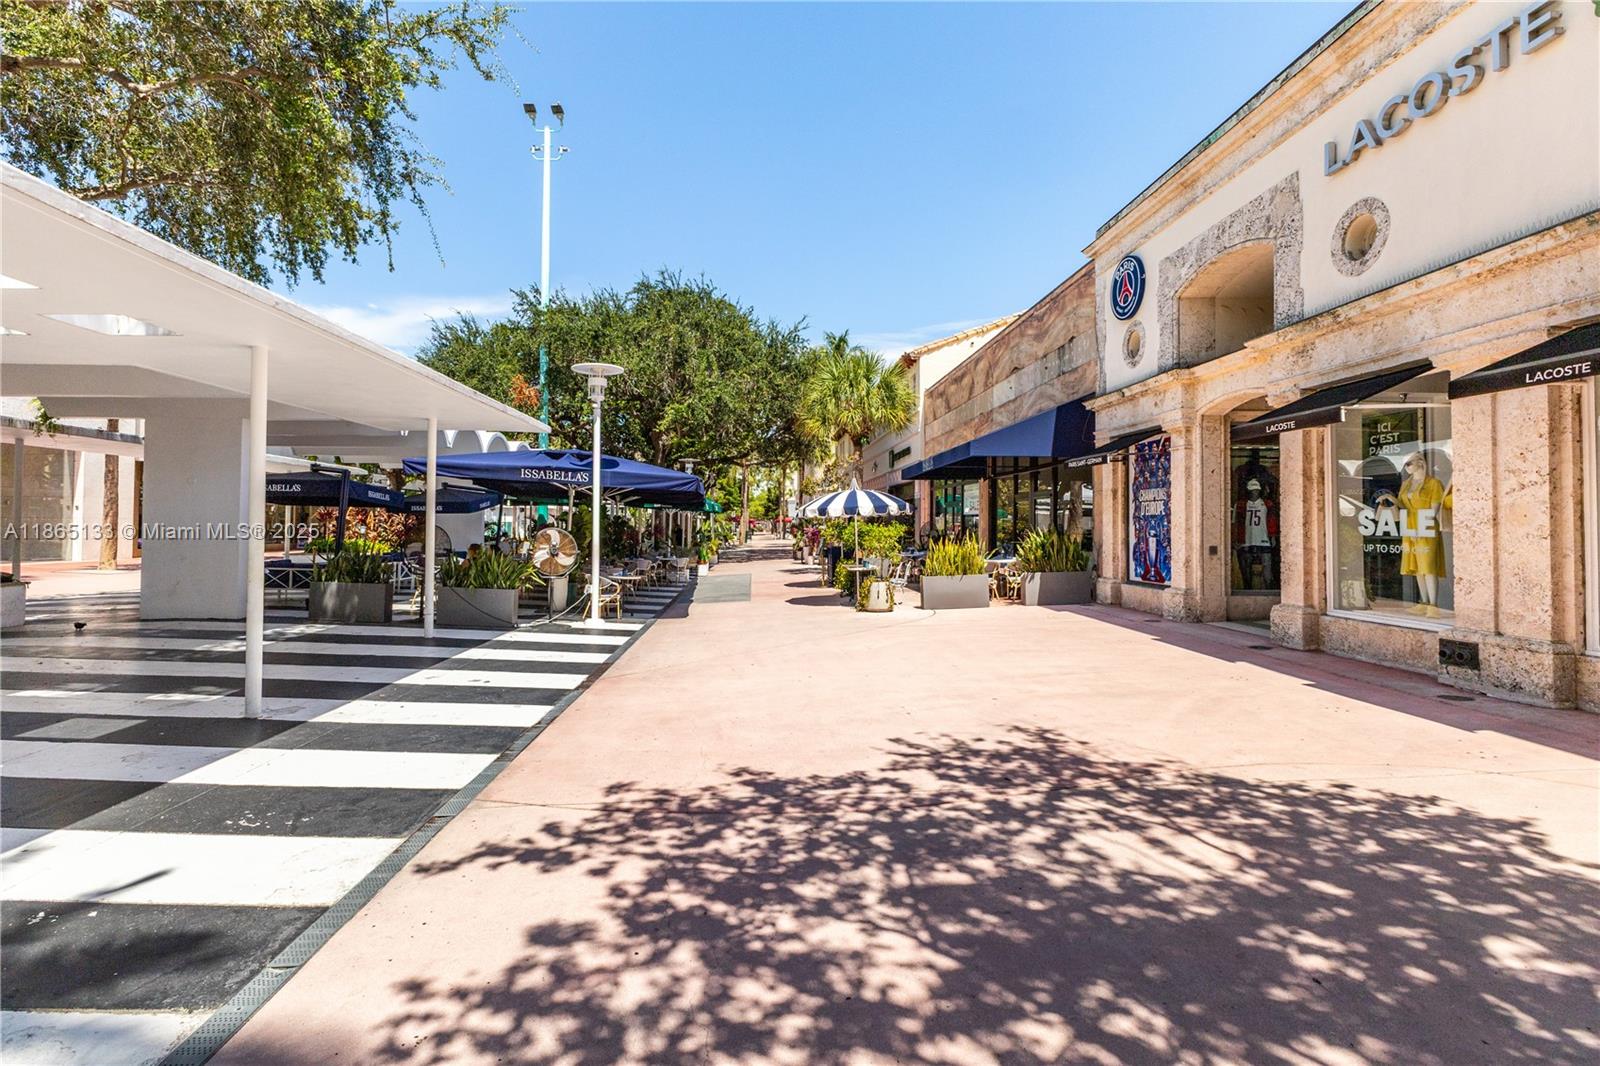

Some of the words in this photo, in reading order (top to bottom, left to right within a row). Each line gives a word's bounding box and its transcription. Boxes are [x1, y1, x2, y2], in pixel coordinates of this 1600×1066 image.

[1324, 0, 1566, 176] LACOSTE
[1114, 260, 1135, 281] PARIS
[1525, 361, 1592, 383] LACOSTE
[1265, 420, 1296, 433] LACOSTE
[1377, 422, 1391, 433] ICI
[1369, 432, 1400, 445] C'EST
[1369, 443, 1401, 456] PARIS
[520, 468, 590, 482] ISSABELLA'S
[1247, 509, 1261, 527] 75
[1357, 508, 1436, 538] SALE
[1363, 543, 1375, 552] UP
[1376, 544, 1388, 553] TO
